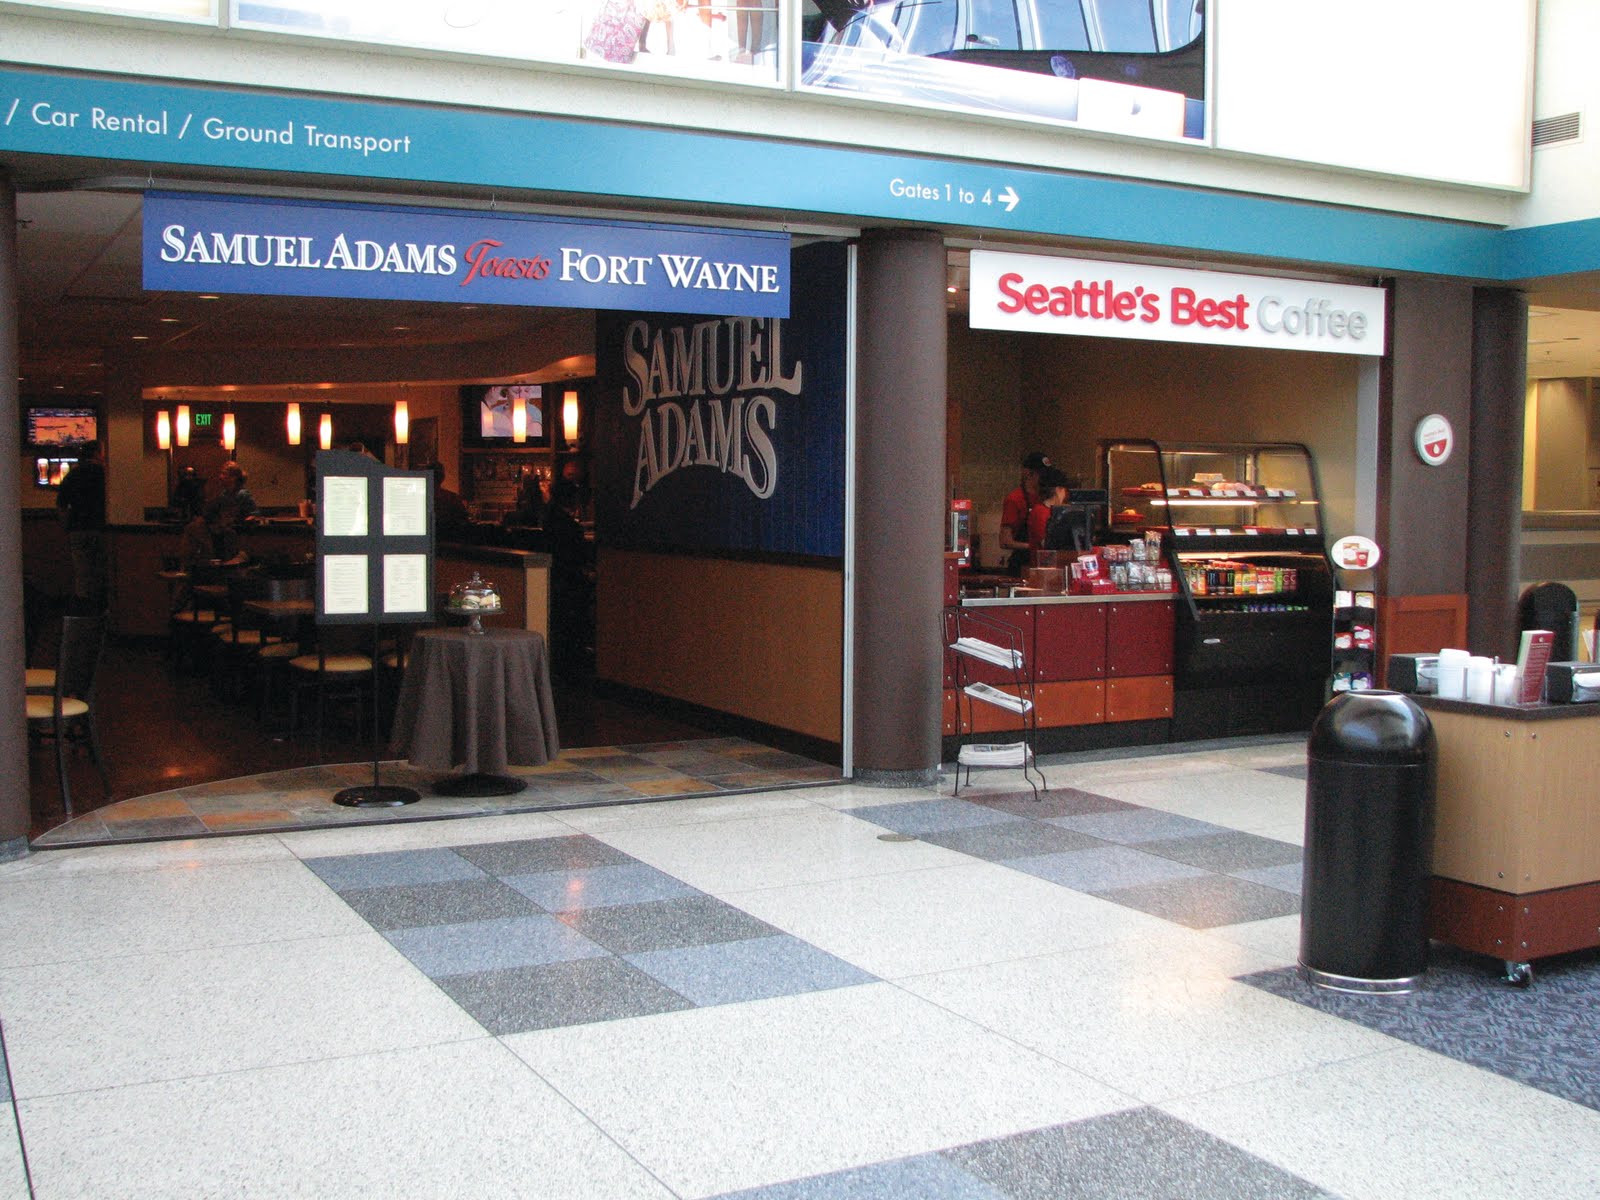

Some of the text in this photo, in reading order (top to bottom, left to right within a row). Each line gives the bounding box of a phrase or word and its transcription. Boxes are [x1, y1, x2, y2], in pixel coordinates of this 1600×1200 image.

[32, 102, 80, 128] Car
[92, 107, 168, 135] Rental
[203, 117, 294, 145] Ground
[304, 125, 411, 157] Transport
[889, 178, 992, 206] Gates 1 to 4
[160, 224, 780, 294] SAMUEL ADAMS Toasts FORT WAYNE
[996, 271, 1369, 341] Seattle's Best Coffee
[622, 316, 803, 416] SAMUEL
[195, 413, 212, 426] EXIT
[629, 395, 778, 510] ADAMS
